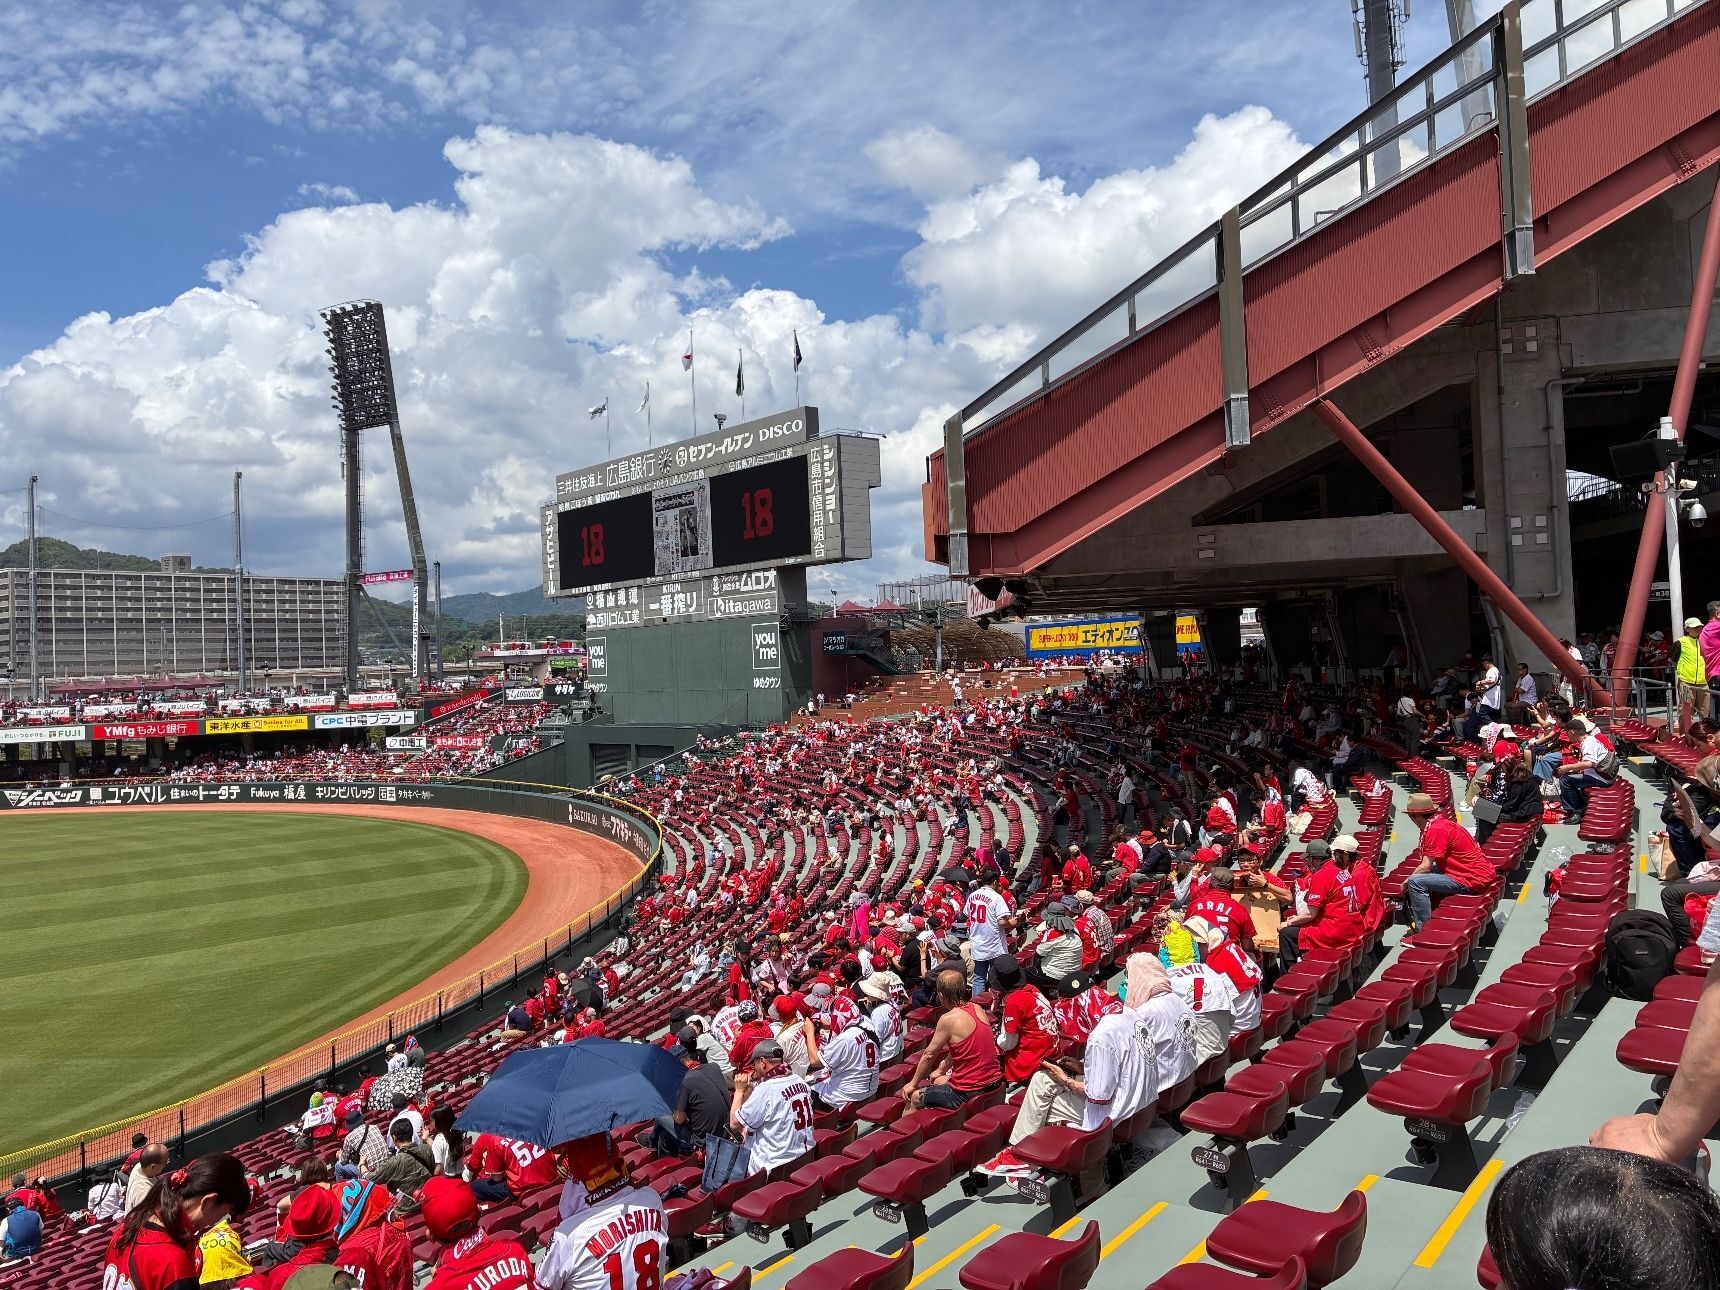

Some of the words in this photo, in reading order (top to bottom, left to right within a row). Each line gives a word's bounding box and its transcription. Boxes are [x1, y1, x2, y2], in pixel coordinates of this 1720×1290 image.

[759, 419, 803, 442] DISCO
[735, 447, 794, 471] 広島アルミニウム工業
[606, 452, 656, 488] 広島銀行
[557, 470, 603, 496] 三井住友海上
[810, 447, 825, 558] 広島市信用組合
[742, 487, 775, 540] 18
[545, 510, 556, 596] アサヒビール
[581, 523, 605, 568] 18
[662, 583, 681, 594] KIRIN
[740, 568, 777, 592] ムロオ
[649, 591, 697, 616] 一番搾り
[596, 608, 640, 627] 西川ゴム工業
[754, 632, 776, 650] you
[1082, 629, 1123, 645] エディオン
[589, 644, 604, 659] you
[759, 647, 778, 660] me
[591, 658, 605, 669] me
[555, 685, 575, 695] サタケ
[753, 676, 781, 689] ゆめタウン
[210, 721, 251, 731] 東洋水産
[322, 717, 344, 725] CPC
[345, 712, 413, 725] 中電プラント
[59, 729, 81, 738] FUJI
[104, 726, 135, 738] YMfg
[137, 723, 187, 735] もみじ銀行
[399, 738, 423, 748] 中電工
[17, 789, 83, 807] ジーベック
[106, 786, 167, 804] ユウベル
[170, 788, 199, 799] 住まいの
[199, 785, 241, 800] トータテ
[250, 787, 280, 799] Fukuya
[283, 785, 306, 800] 福屋
[315, 786, 376, 799] キリンビバレッジ
[970, 904, 986, 923] 20
[715, 1011, 737, 1029] KURODA
[865, 1042, 876, 1068] 9
[792, 1096, 813, 1131] 31
[511, 1141, 545, 1167] 52
[453, 1226, 485, 1259] Carp
[587, 1209, 662, 1258] MORISHITA
[603, 1239, 661, 1290] 18
